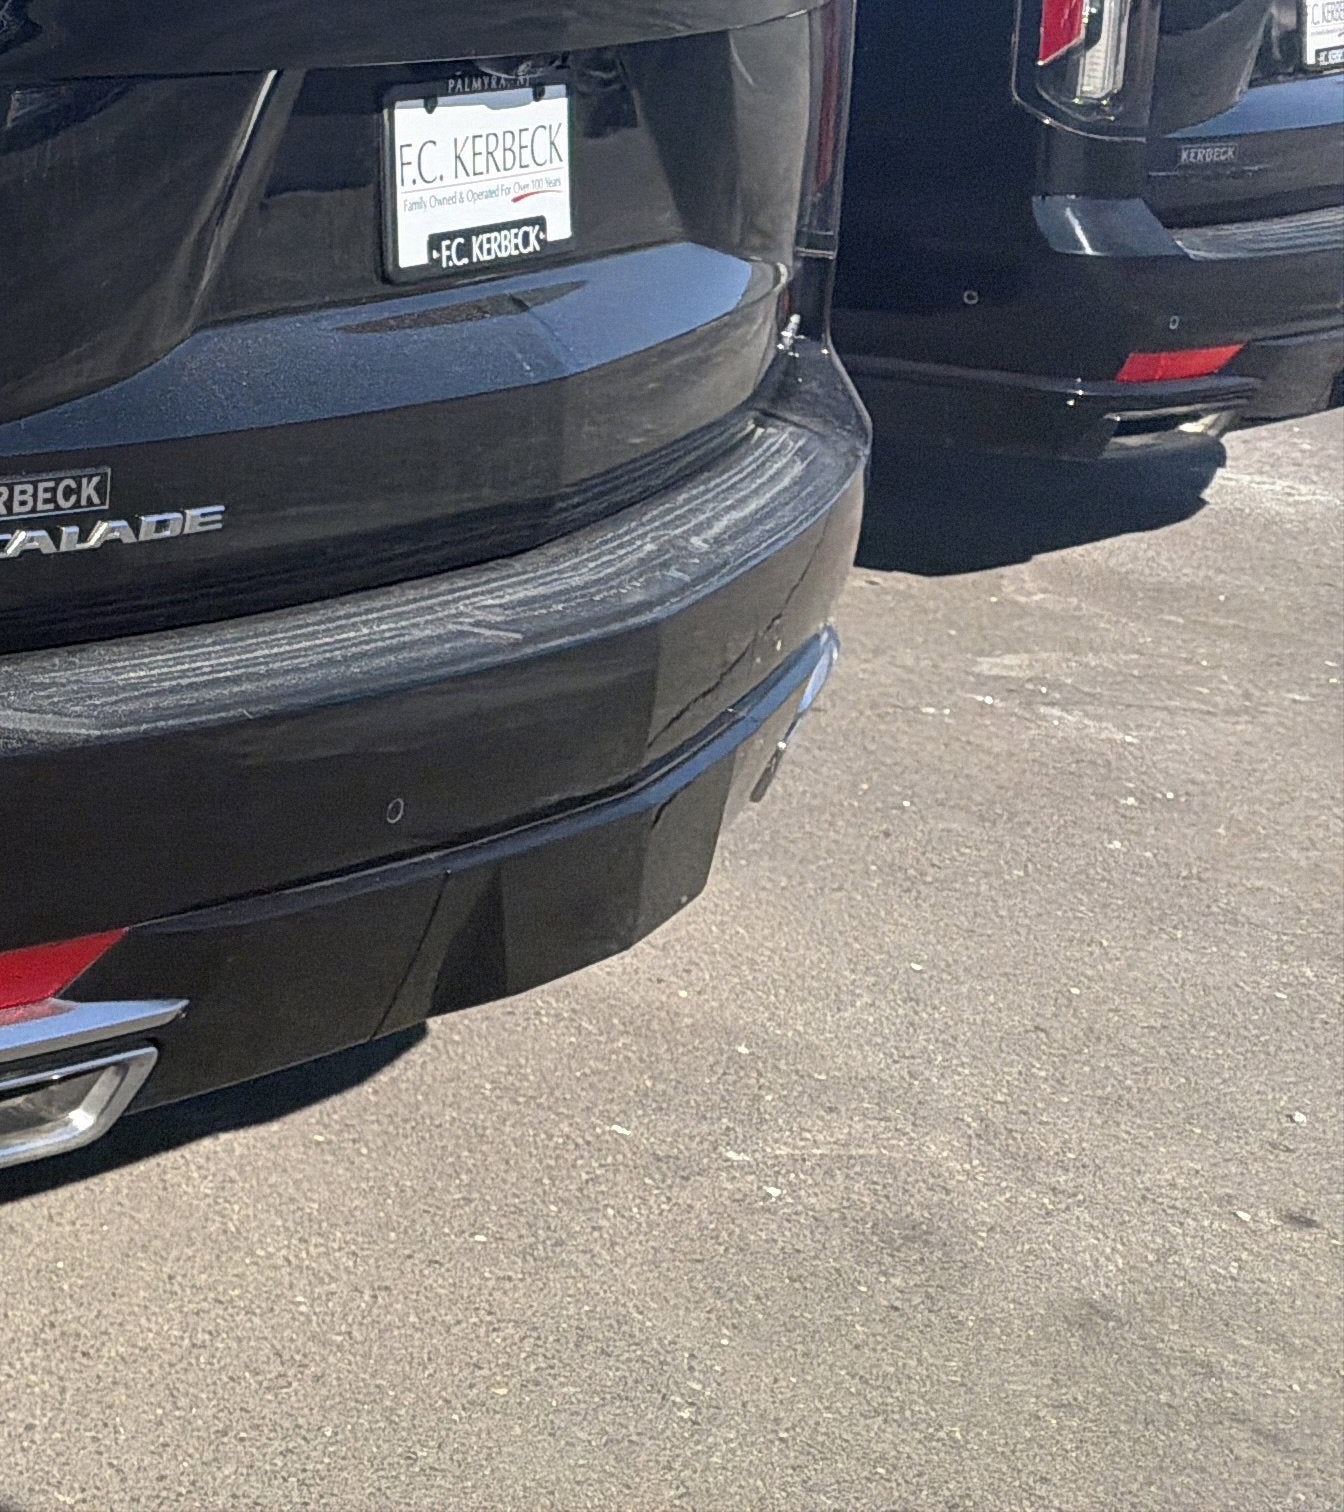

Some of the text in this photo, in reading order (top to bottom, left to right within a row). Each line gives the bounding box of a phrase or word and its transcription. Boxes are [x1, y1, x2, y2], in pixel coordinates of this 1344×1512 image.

[399, 122, 564, 187] F.C. KERBECK
[403, 176, 562, 212] Family Owned & Operated For Over 100 Years
[441, 224, 541, 268] F.C. KERBECK
